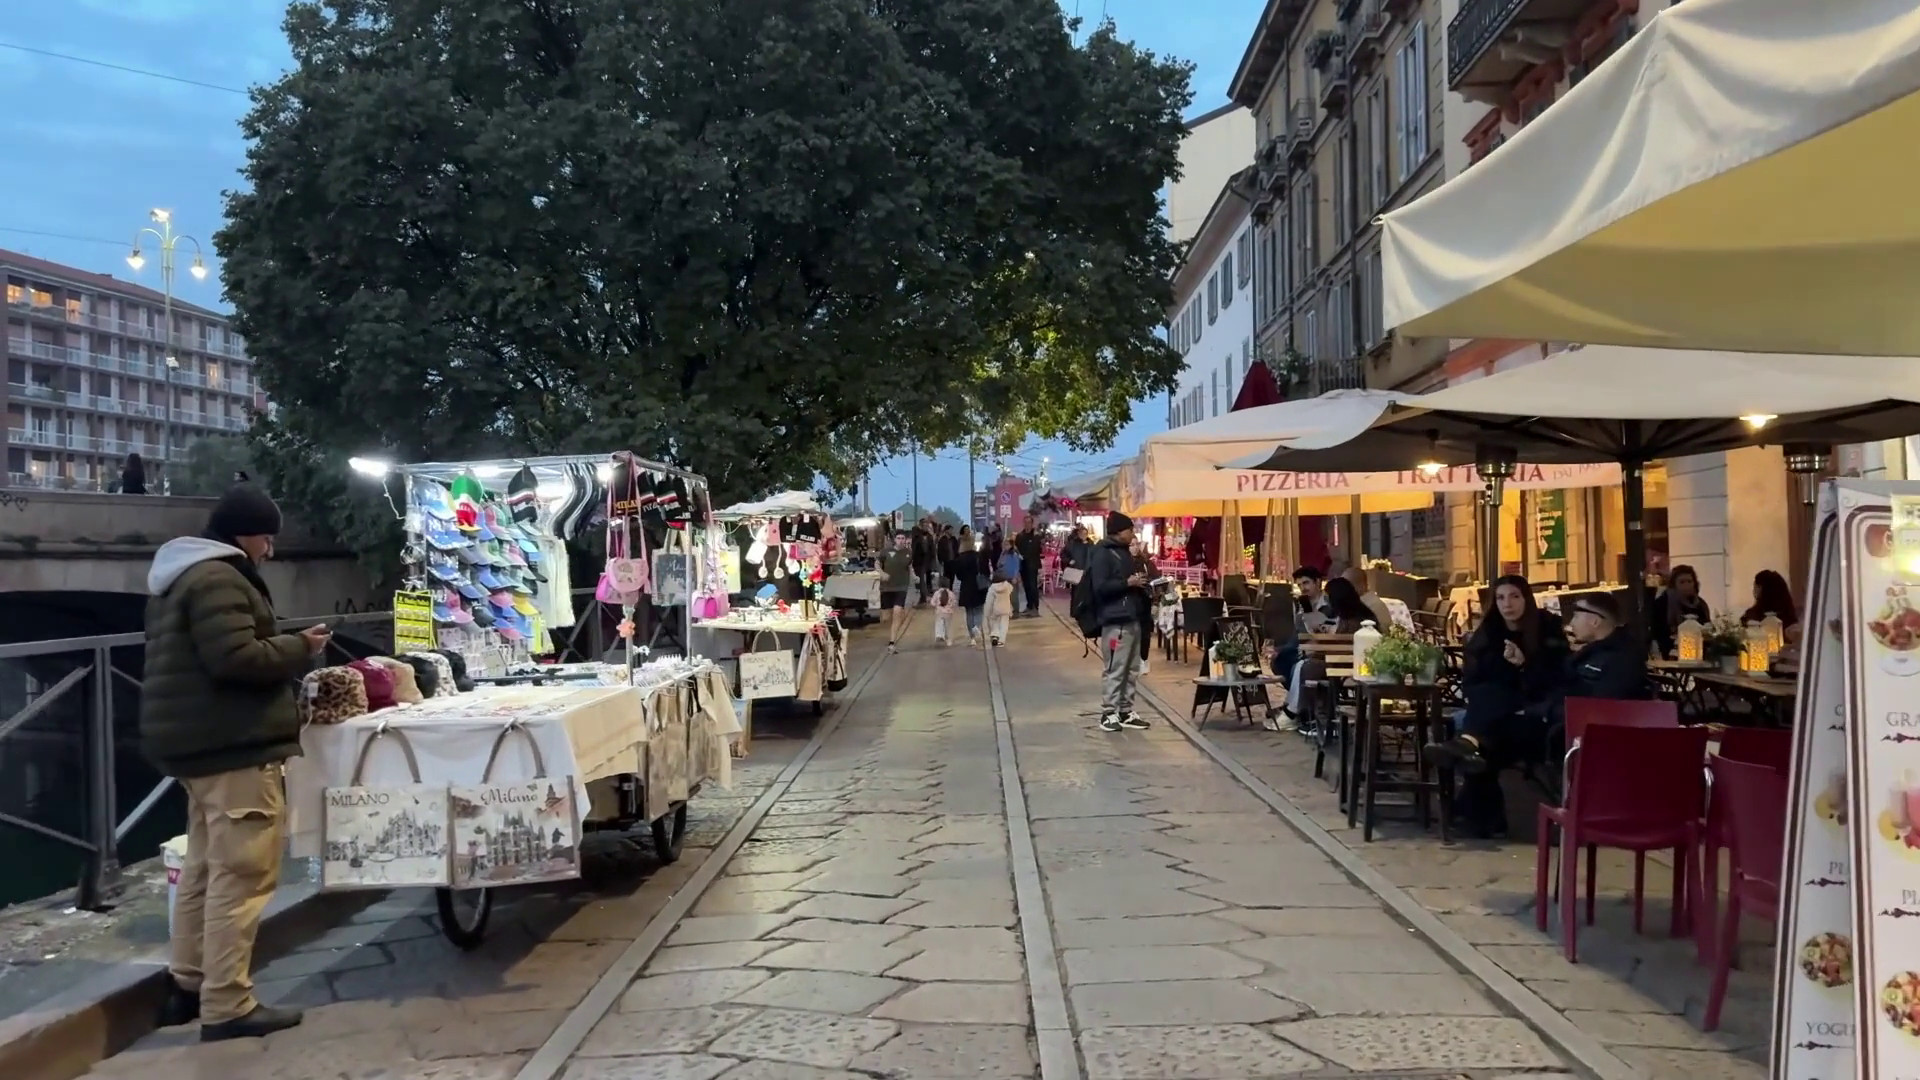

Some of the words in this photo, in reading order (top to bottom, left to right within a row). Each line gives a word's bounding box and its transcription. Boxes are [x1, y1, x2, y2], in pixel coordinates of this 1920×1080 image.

[1236, 471, 1350, 492] PIZZERIA
[331, 793, 390, 807] MILANO
[480, 788, 538, 805] Milano
